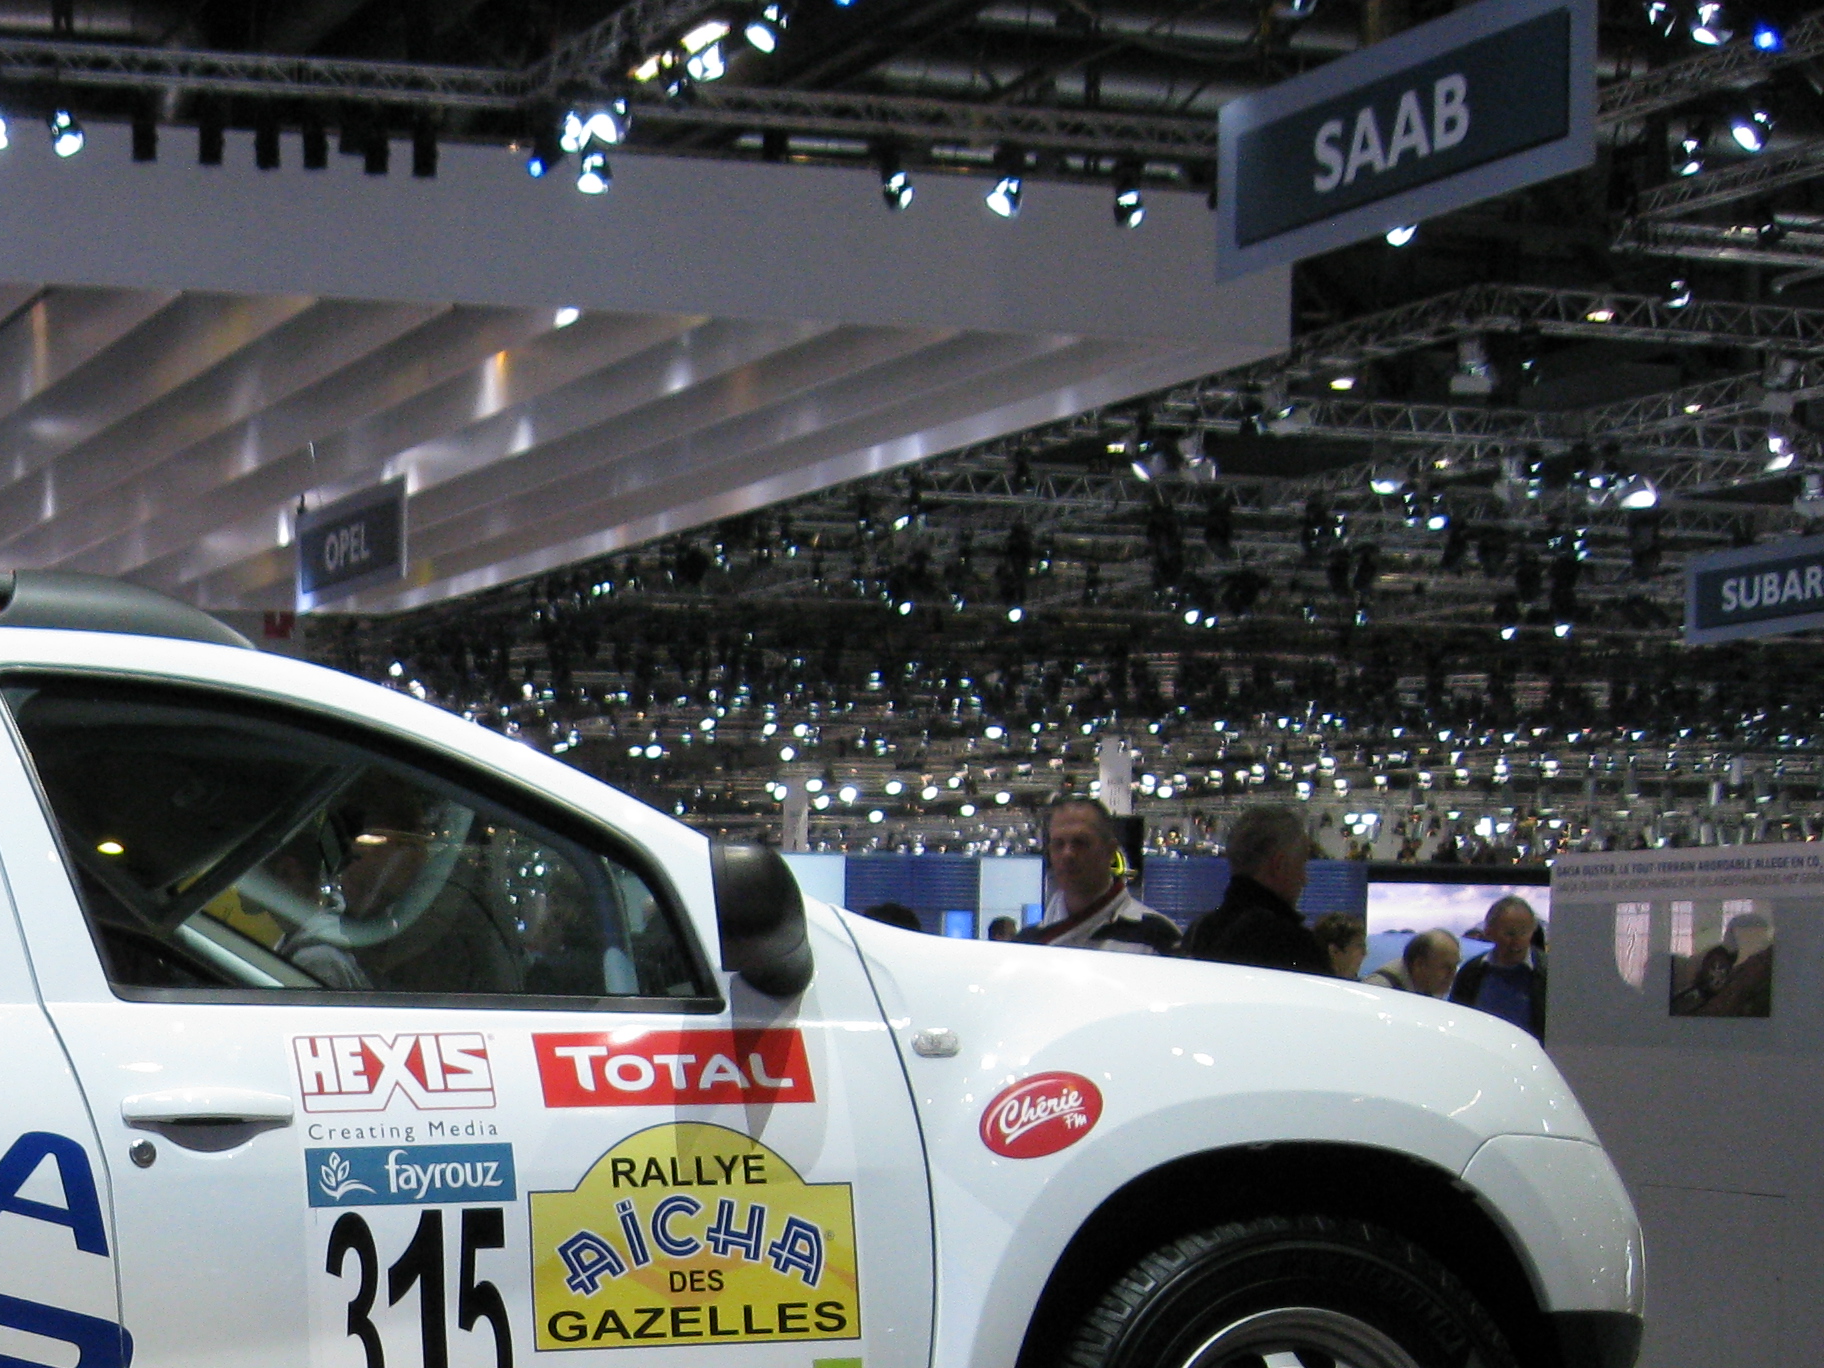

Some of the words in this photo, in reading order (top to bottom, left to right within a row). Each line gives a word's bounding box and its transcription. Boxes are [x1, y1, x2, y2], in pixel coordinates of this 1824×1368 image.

[1313, 73, 1471, 194] SAAB
[325, 521, 370, 572] OPEL
[293, 1032, 497, 1113] HEXIS
[555, 1046, 795, 1092] TOTAL
[308, 1123, 415, 1142] Creating
[429, 1120, 498, 1137] Media
[998, 1088, 1084, 1135] Chérie
[384, 1149, 503, 1200] fayrouz
[611, 1154, 768, 1188] RALLYE
[669, 1270, 724, 1293] DES
[548, 1301, 847, 1342] GAZELLES
